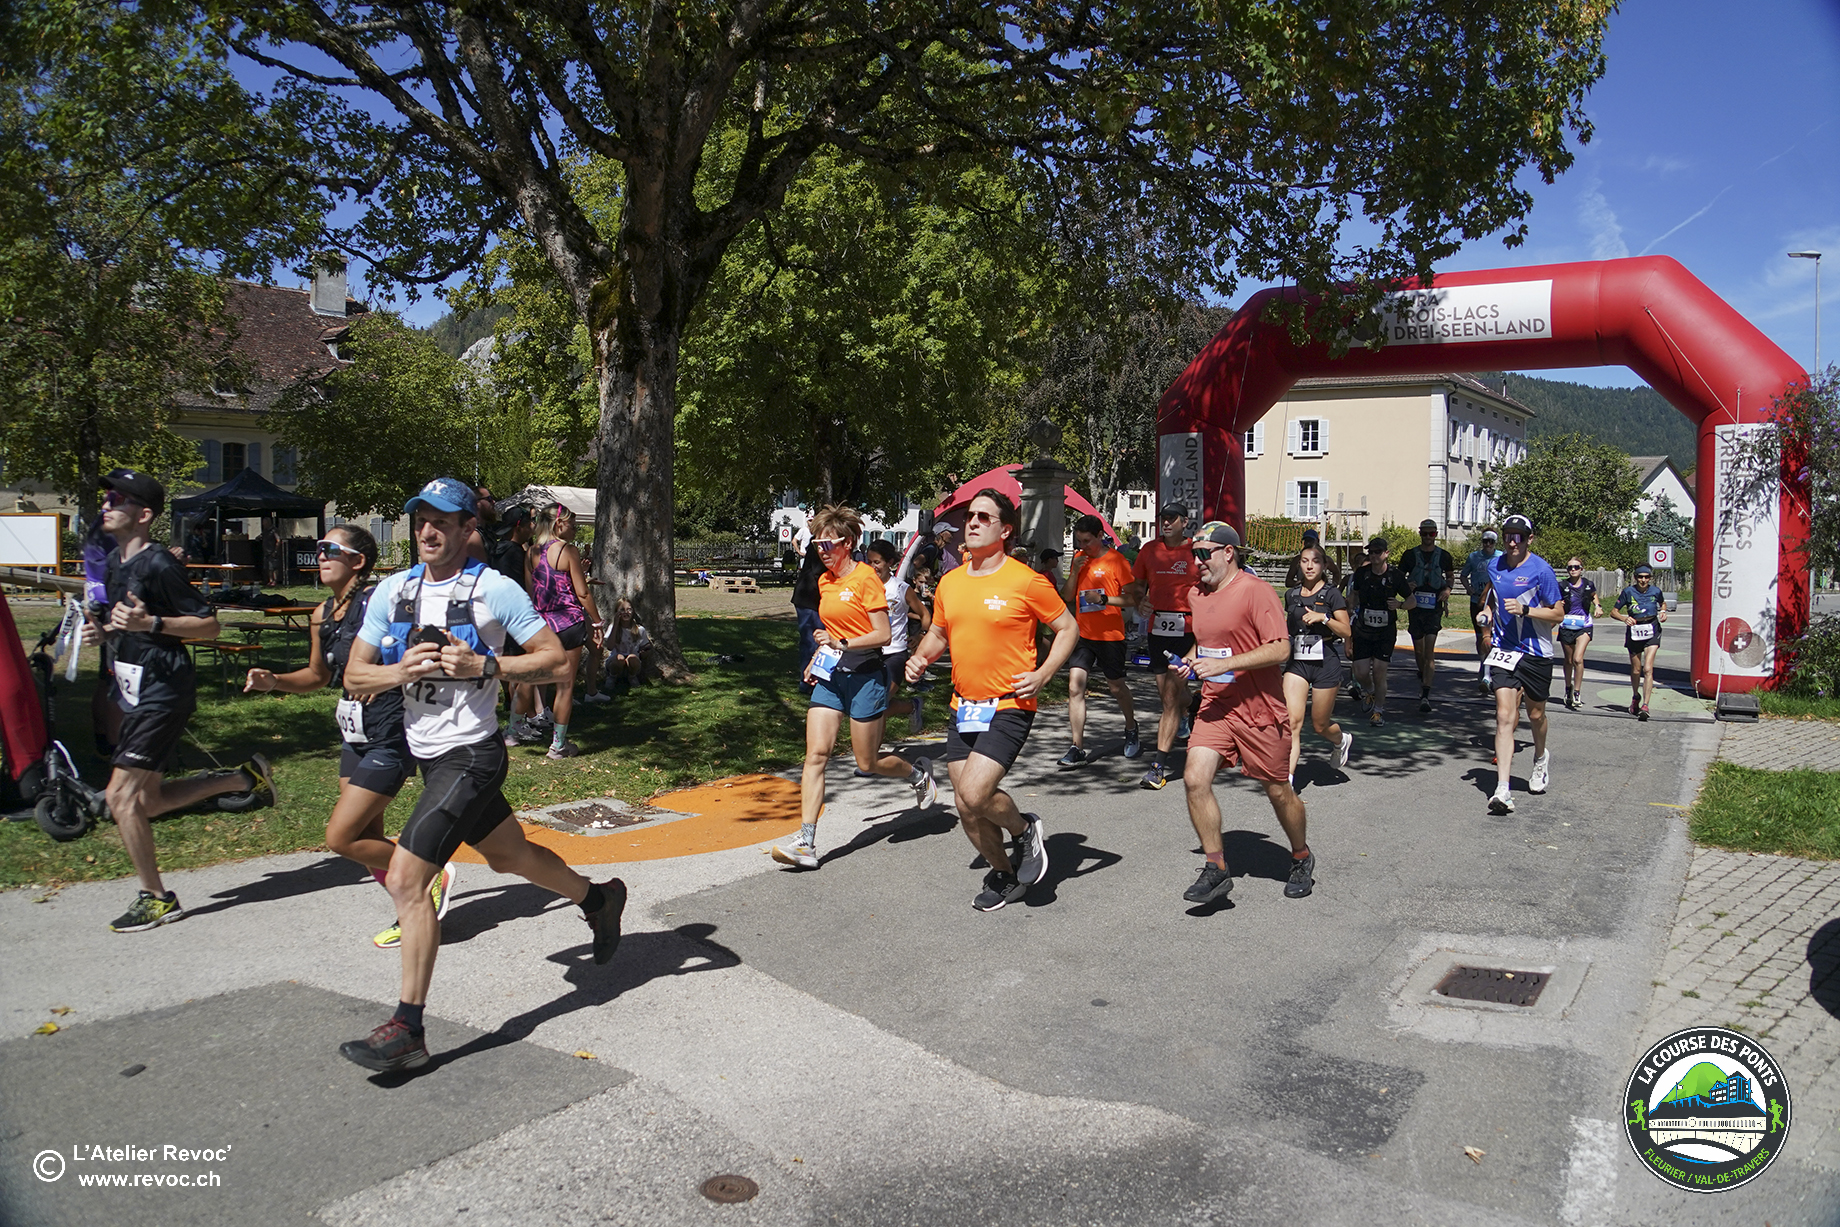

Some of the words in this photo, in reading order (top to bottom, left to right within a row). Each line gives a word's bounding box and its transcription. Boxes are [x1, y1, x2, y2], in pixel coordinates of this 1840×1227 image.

[1394, 318, 1546, 340] DREI-SEEN-LAND
[296, 553, 319, 565] BOX
[1419, 596, 1430, 604] 38
[1368, 616, 1383, 624] 113
[1161, 621, 1176, 632] 92
[1635, 629, 1649, 637] 112
[1300, 644, 1312, 655] 77
[815, 653, 826, 667] 21
[1492, 652, 1512, 664] 132
[963, 706, 982, 721] 22
